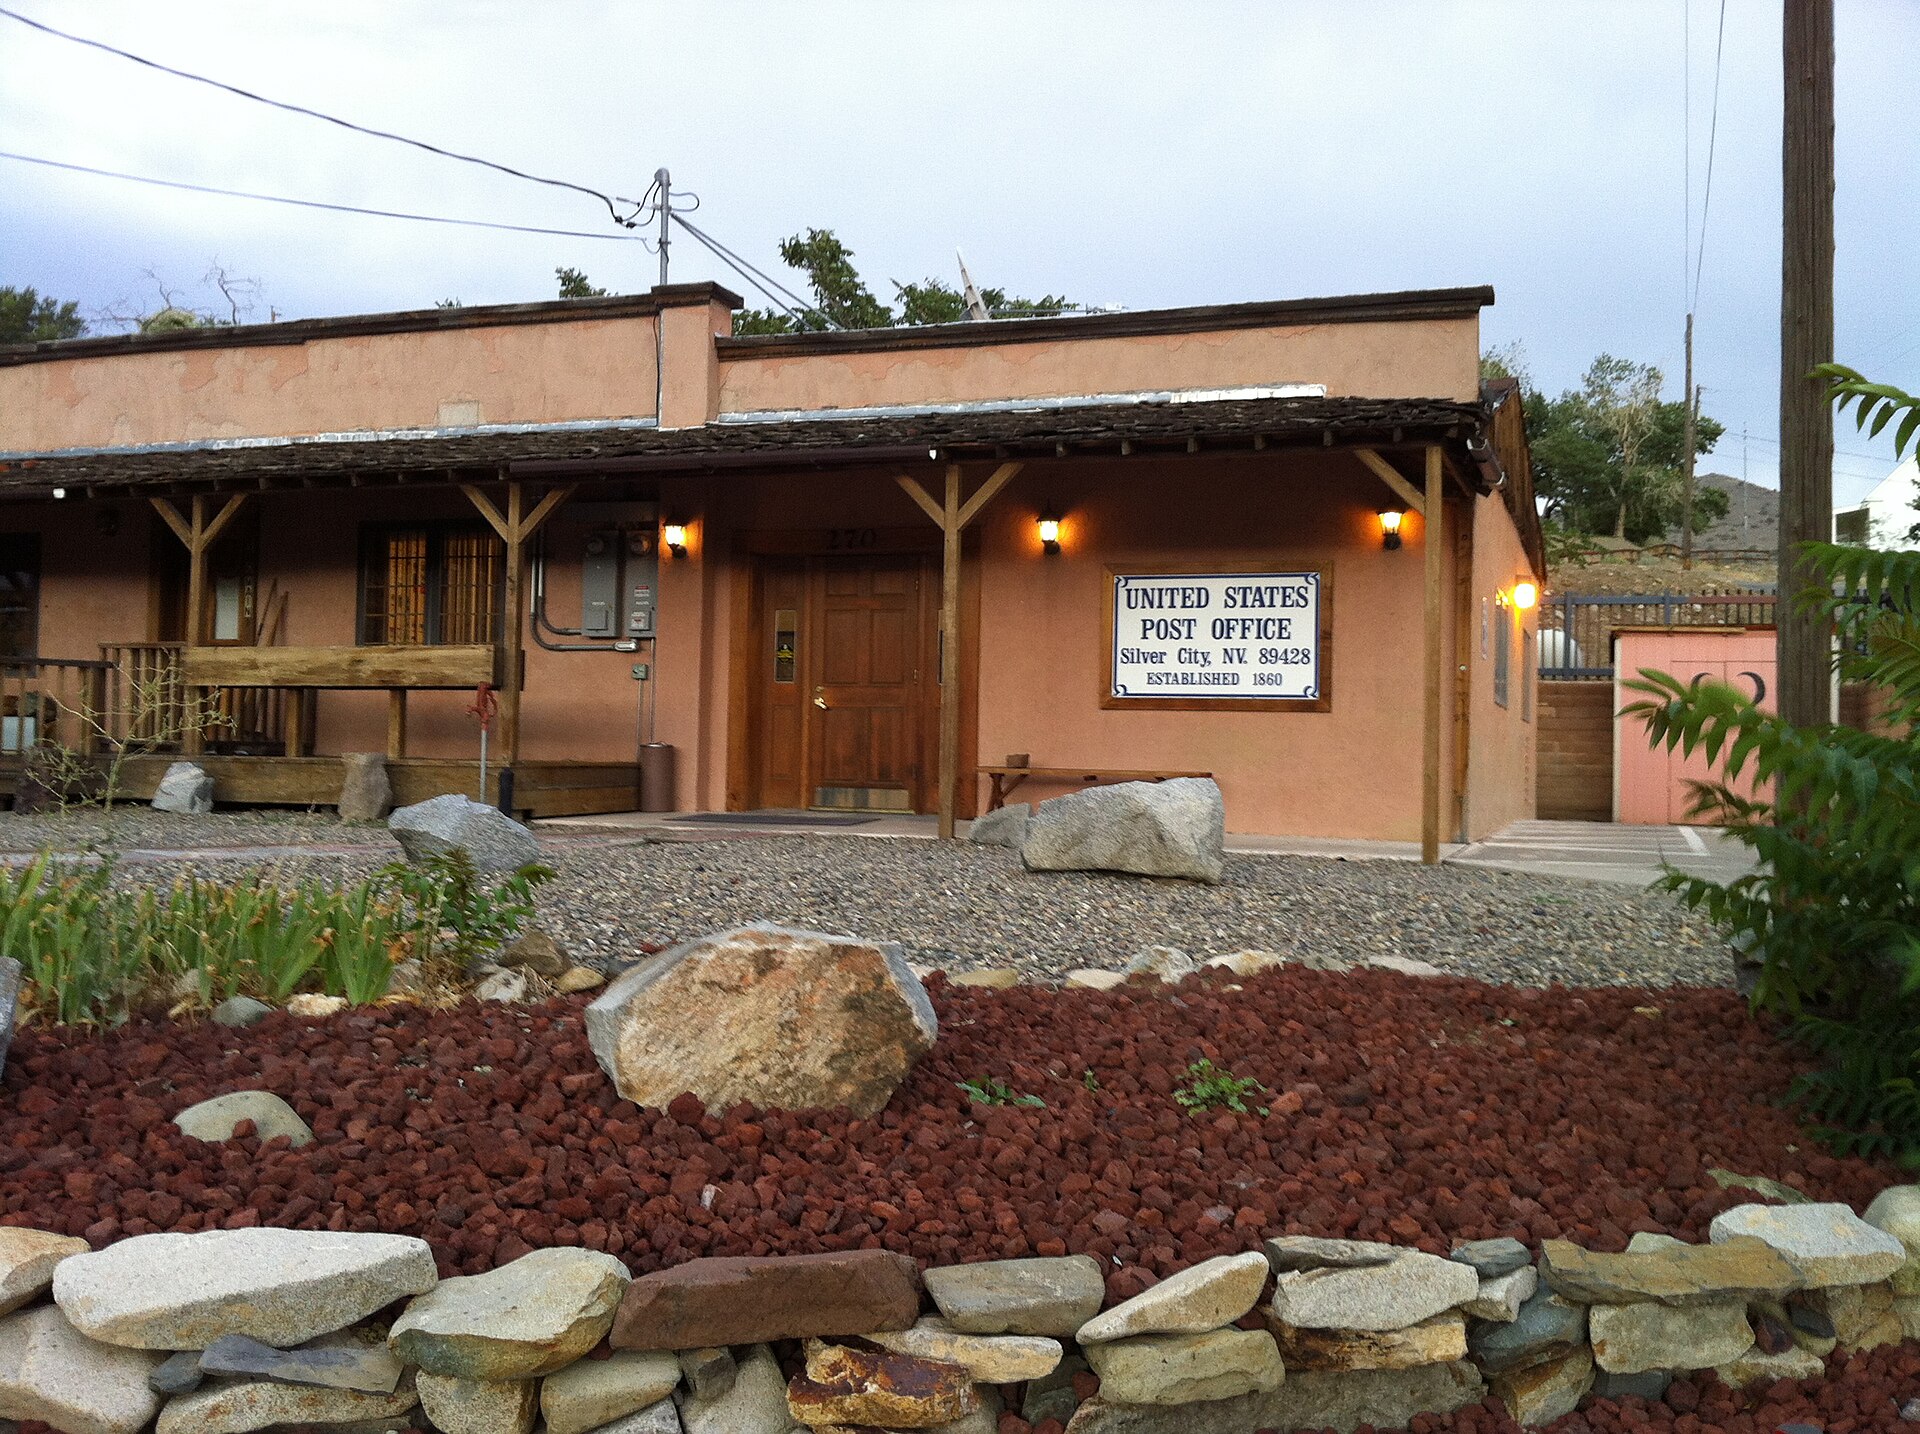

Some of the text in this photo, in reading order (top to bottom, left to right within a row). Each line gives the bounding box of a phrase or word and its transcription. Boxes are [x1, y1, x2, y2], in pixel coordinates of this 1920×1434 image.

[1125, 585, 1309, 610] UNITED STATES
[1140, 618, 1291, 640] POST OFFICE
[1120, 647, 1311, 668] Silver City, NV. 89428
[1146, 672, 1283, 686] ESTABLISHED 1860
